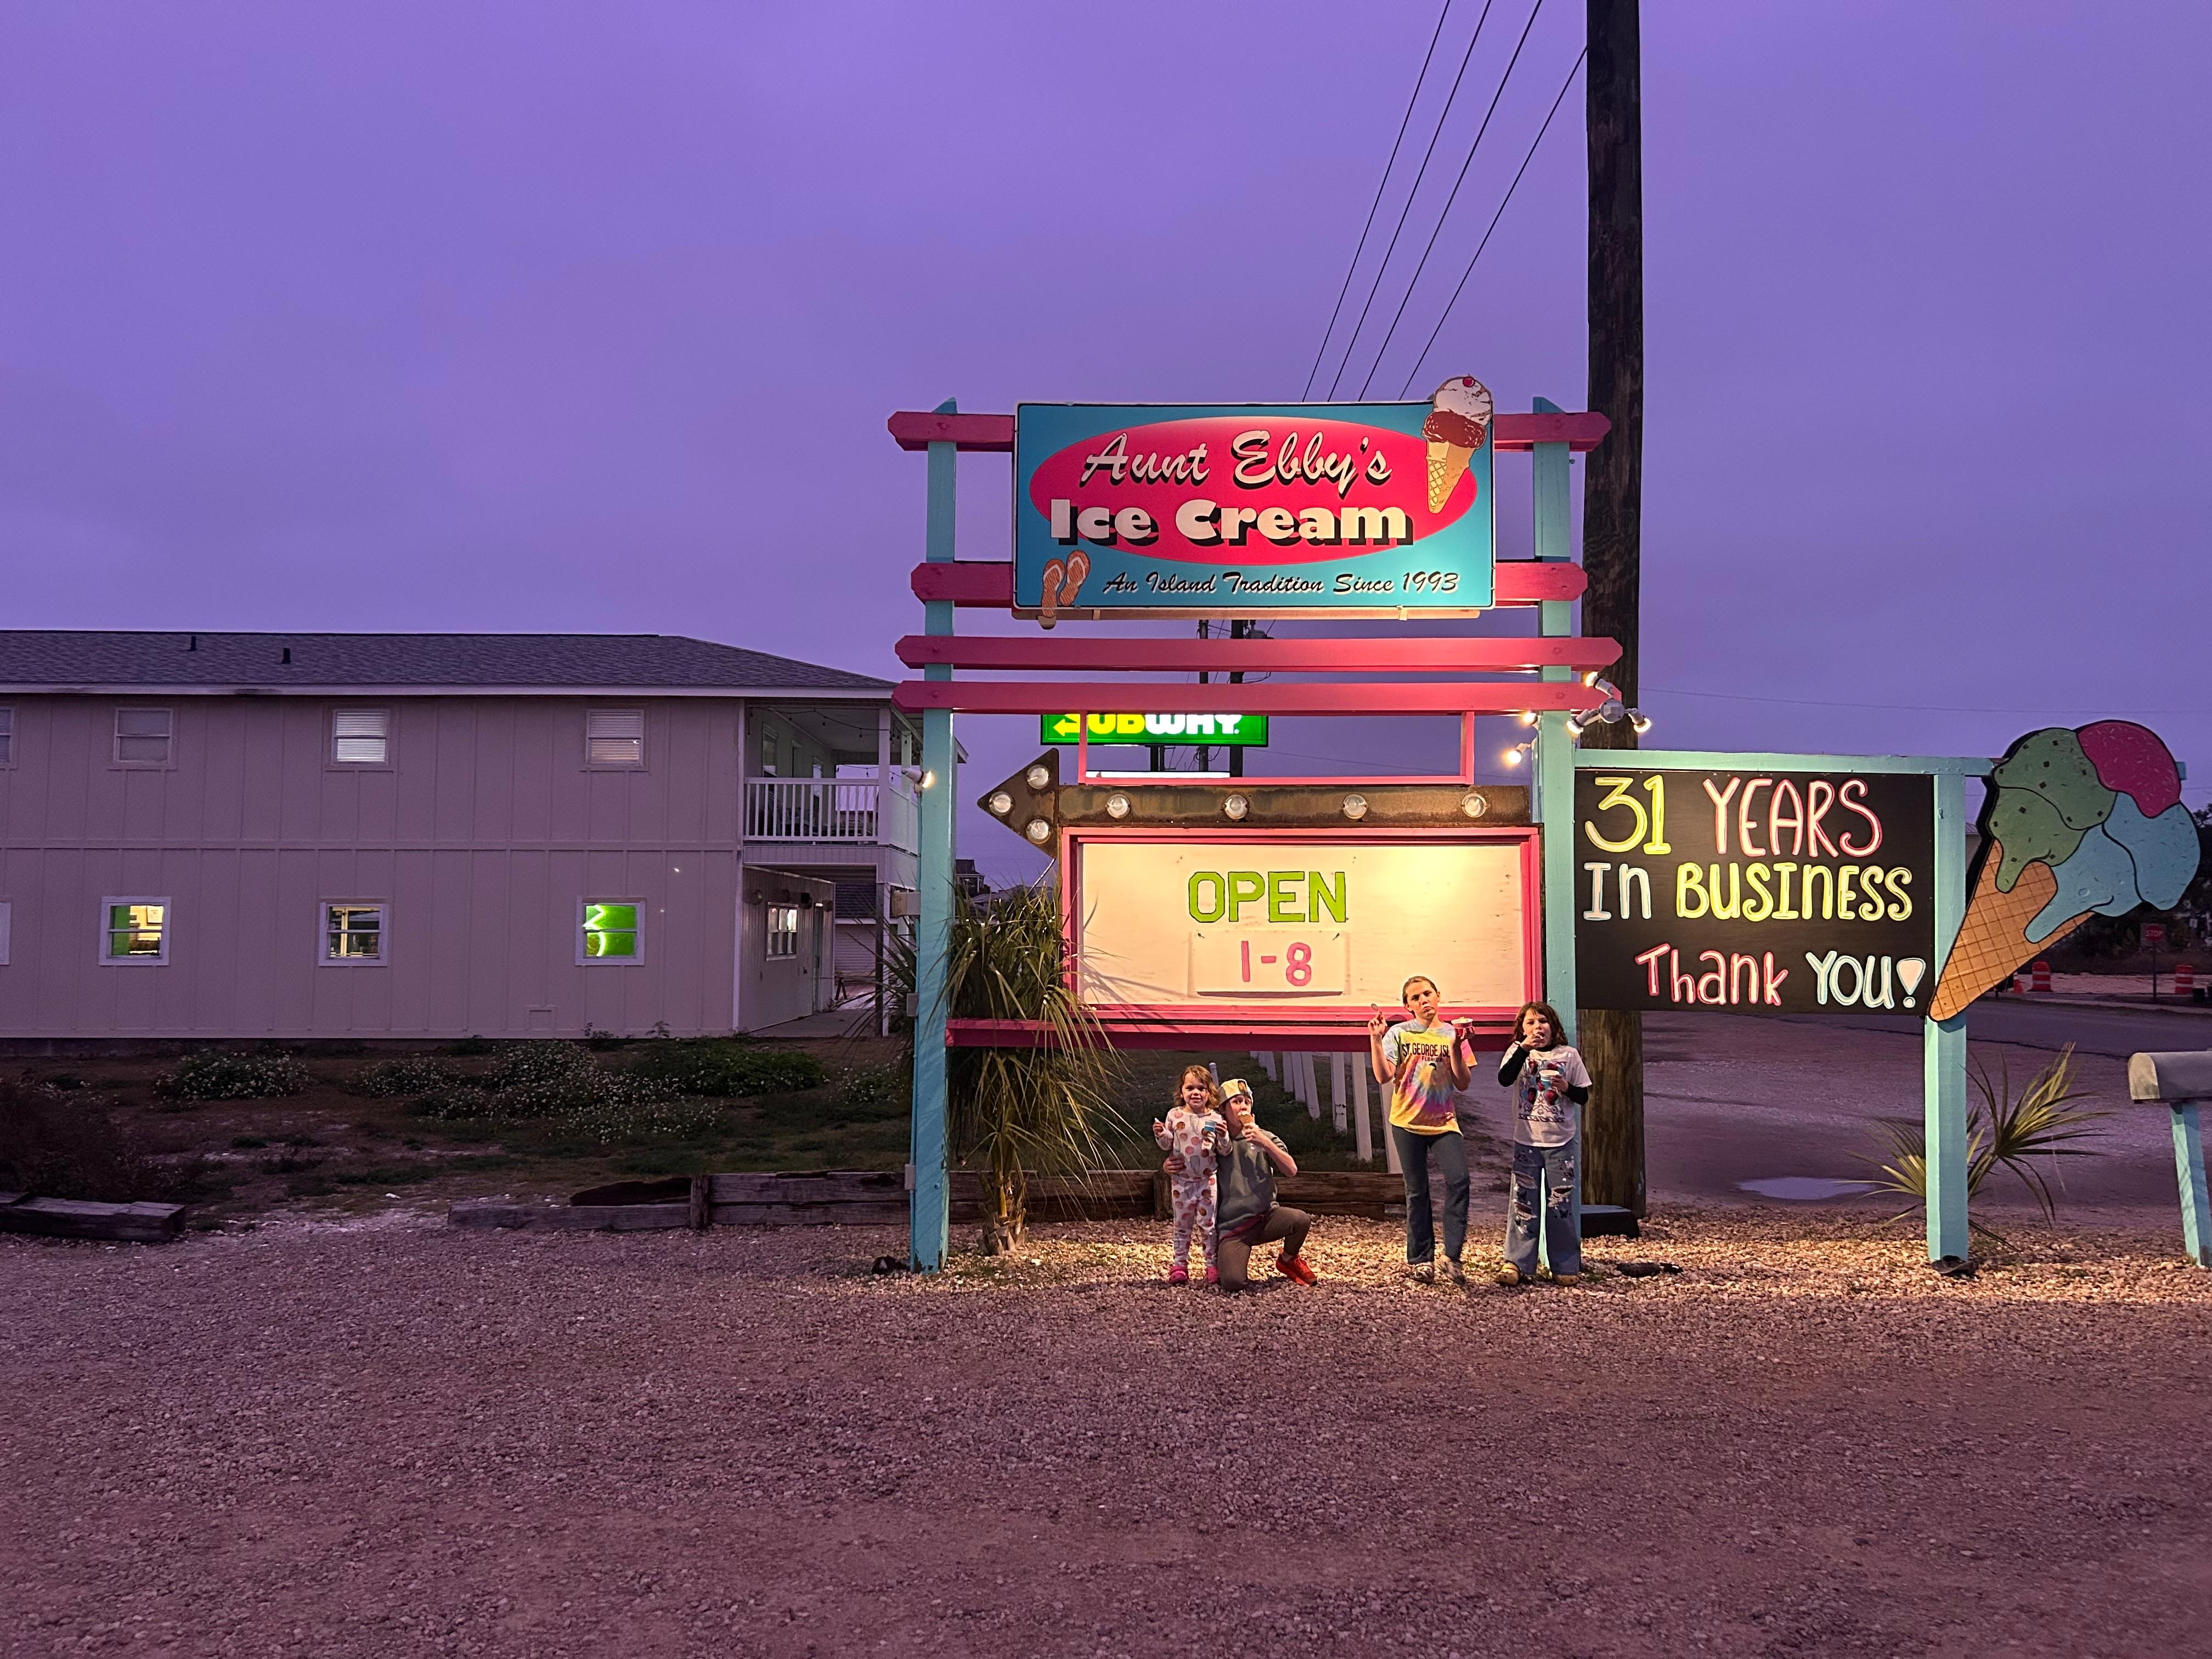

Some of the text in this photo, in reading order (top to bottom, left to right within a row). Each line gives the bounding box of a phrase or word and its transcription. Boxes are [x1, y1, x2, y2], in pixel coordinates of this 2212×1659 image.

[1080, 430, 1392, 495] Aunt Ebby's
[1050, 498, 1409, 542] Ice Cream
[1102, 571, 1460, 594] An Island Tradition Since 1993
[1584, 774, 1883, 857] 31 YEARS
[1188, 870, 1347, 923] OPEN
[1583, 862, 1914, 922] In BUSINESS
[1635, 943, 1927, 1009] Thank YOU!
